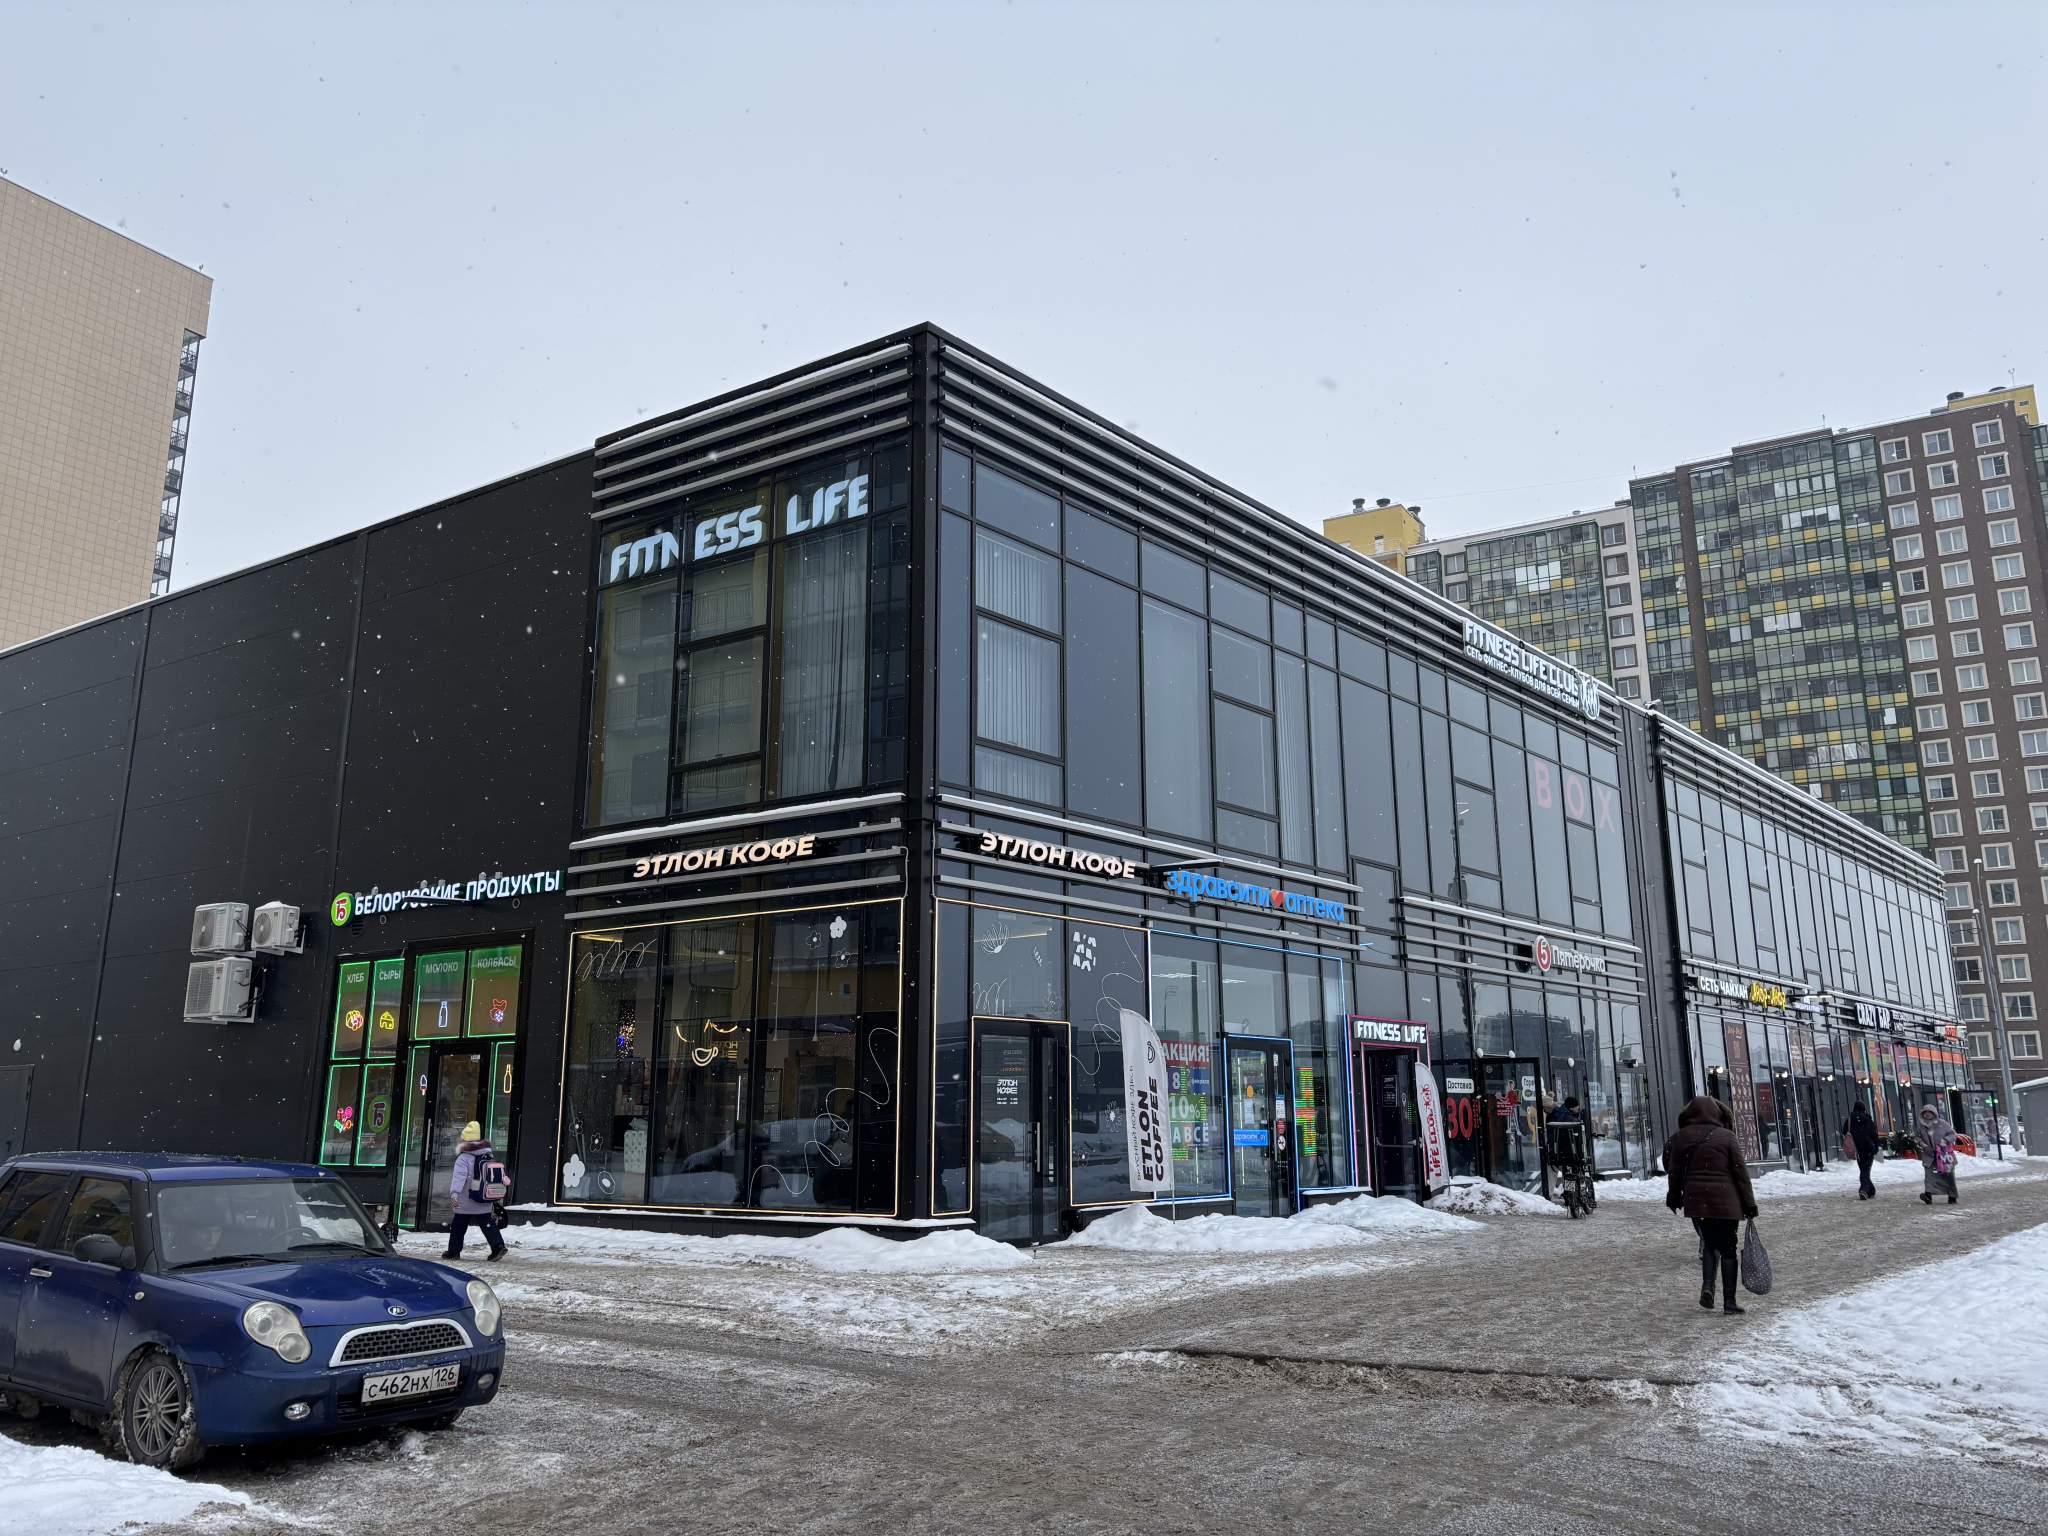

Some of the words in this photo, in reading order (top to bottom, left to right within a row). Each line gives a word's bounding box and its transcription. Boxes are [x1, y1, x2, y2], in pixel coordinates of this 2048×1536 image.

[786, 474, 869, 536] LIFE
[1465, 621, 1520, 667] FITNESS
[1521, 650, 1549, 681] LIFE
[1466, 645, 1483, 661] СЕТЬ
[1483, 652, 1534, 686] ФИТНЕС-КЛУБОВ
[1535, 760, 1615, 833] BOX
[632, 847, 725, 879] ЭТЛОН
[730, 834, 817, 866] КОФЕ
[978, 831, 1067, 869] ЭТЛОН
[1069, 849, 1136, 880] КОФЕ
[465, 870, 560, 901] ПРОДУКТЫ
[1163, 870, 1271, 908] здравсити
[1284, 895, 1345, 922] аптека
[346, 972, 365, 984] ХЛЕБ
[379, 969, 401, 981] СЫРЫ
[425, 961, 459, 974] МОЛОКО
[477, 956, 517, 969] КОЛБАСЫ
[1698, 975, 1720, 994] СЕТЬ
[1720, 979, 1748, 999] ЧАЙХАН
[1356, 1020, 1401, 1042] FITNESS
[1403, 1024, 1427, 1044] LIFE
[1163, 1043, 1209, 1064] АКЦИЯ!
[1447, 1080, 1472, 1090] Доставка
[1137, 1089, 1154, 1182] ETLON
[1149, 1076, 1164, 1181] COFFEE
[1447, 1096, 1473, 1140] 30
[434, 1366, 455, 1383] 126
